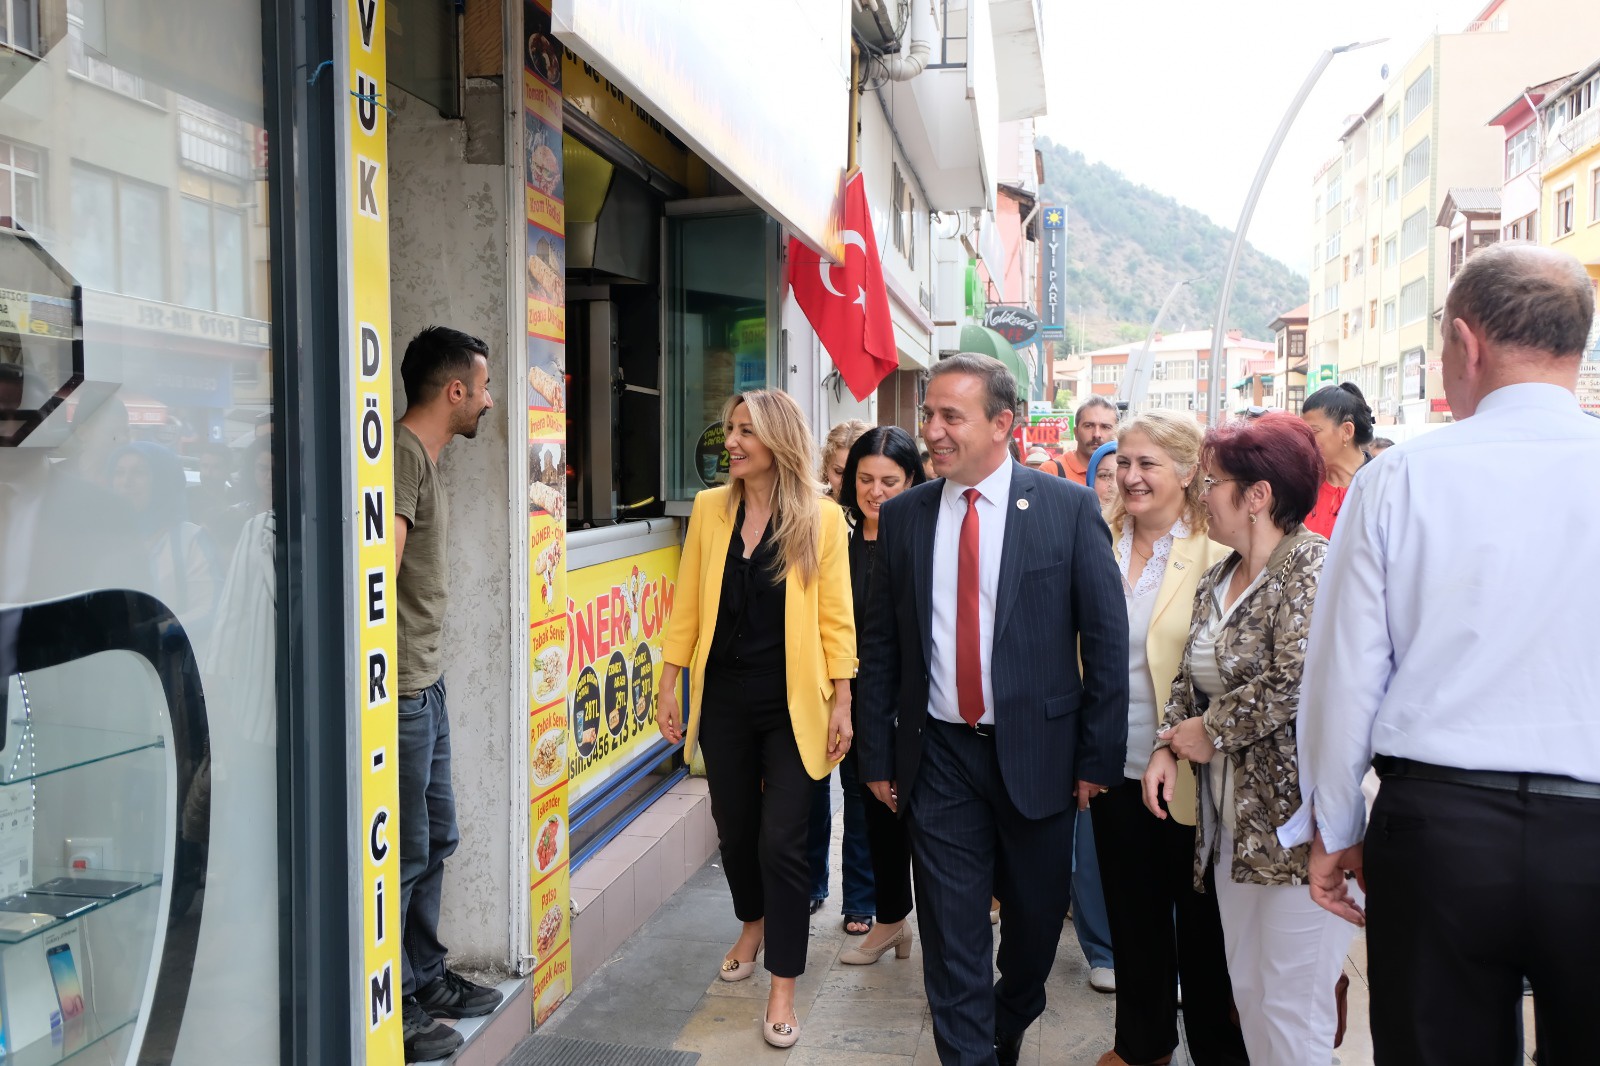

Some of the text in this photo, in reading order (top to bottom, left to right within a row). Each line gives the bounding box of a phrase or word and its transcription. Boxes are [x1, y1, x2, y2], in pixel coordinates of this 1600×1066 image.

[1048, 229, 1059, 268] İYİ
[1048, 270, 1058, 324] PARTİ
[704, 436, 726, 447] +AYRA
[531, 525, 551, 548] DÖNER
[533, 624, 565, 652] Tabak Servis
[536, 713, 552, 737] Tabak
[533, 965, 553, 1001] Ekmek
